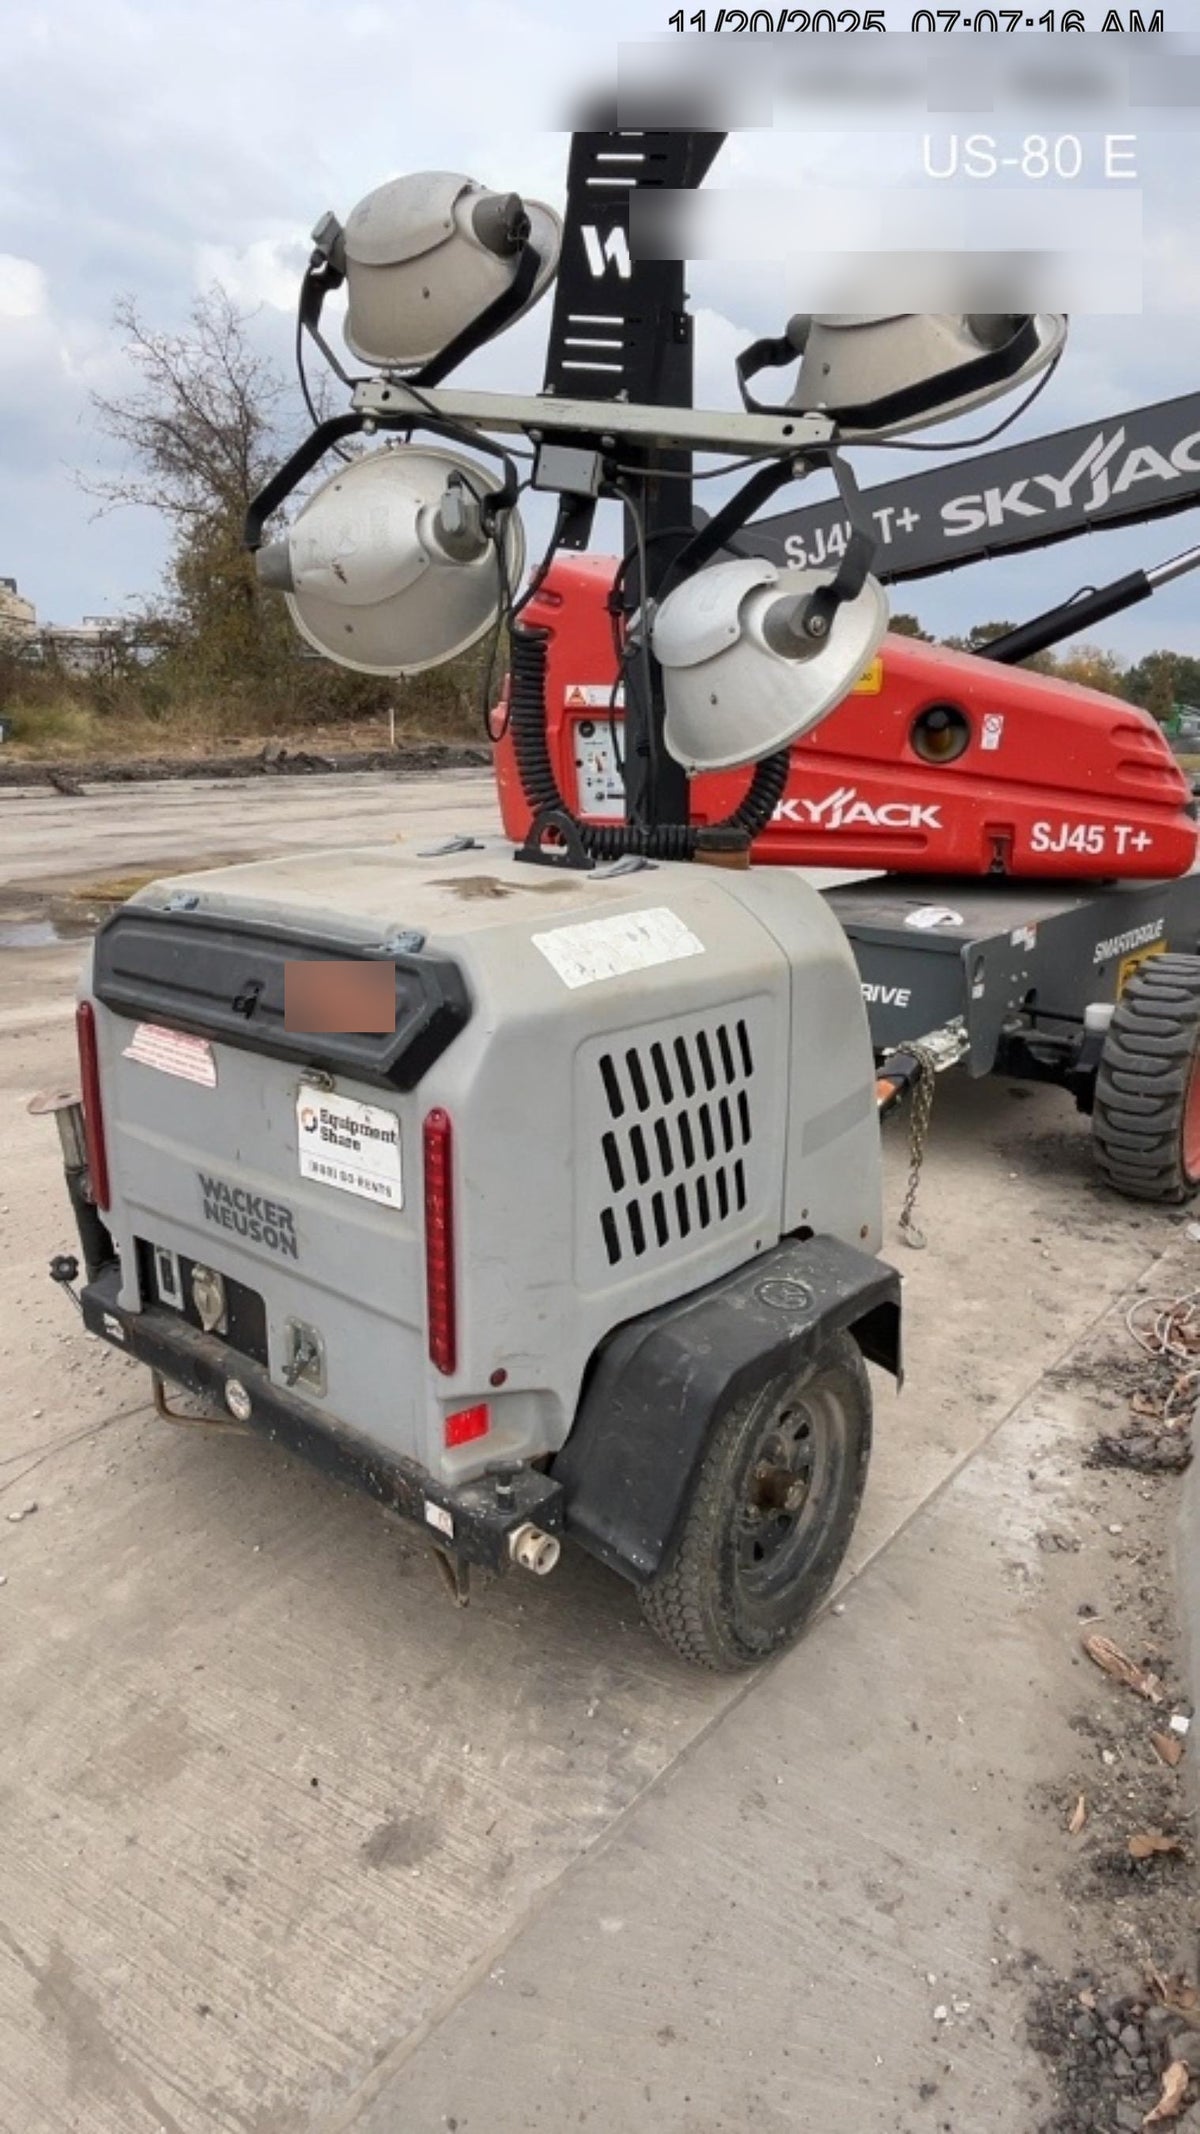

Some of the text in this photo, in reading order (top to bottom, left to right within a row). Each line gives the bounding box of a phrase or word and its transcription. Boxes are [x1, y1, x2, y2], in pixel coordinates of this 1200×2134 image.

[784, 425, 1200, 571] SJ4 T+ SKYJAC
[772, 787, 943, 830] KYJACK
[1030, 821, 1153, 855] SJ45 T+
[861, 983, 912, 1008] RIVE
[198, 1172, 295, 1234] WACKER
[203, 1198, 299, 1260] NEUSON
